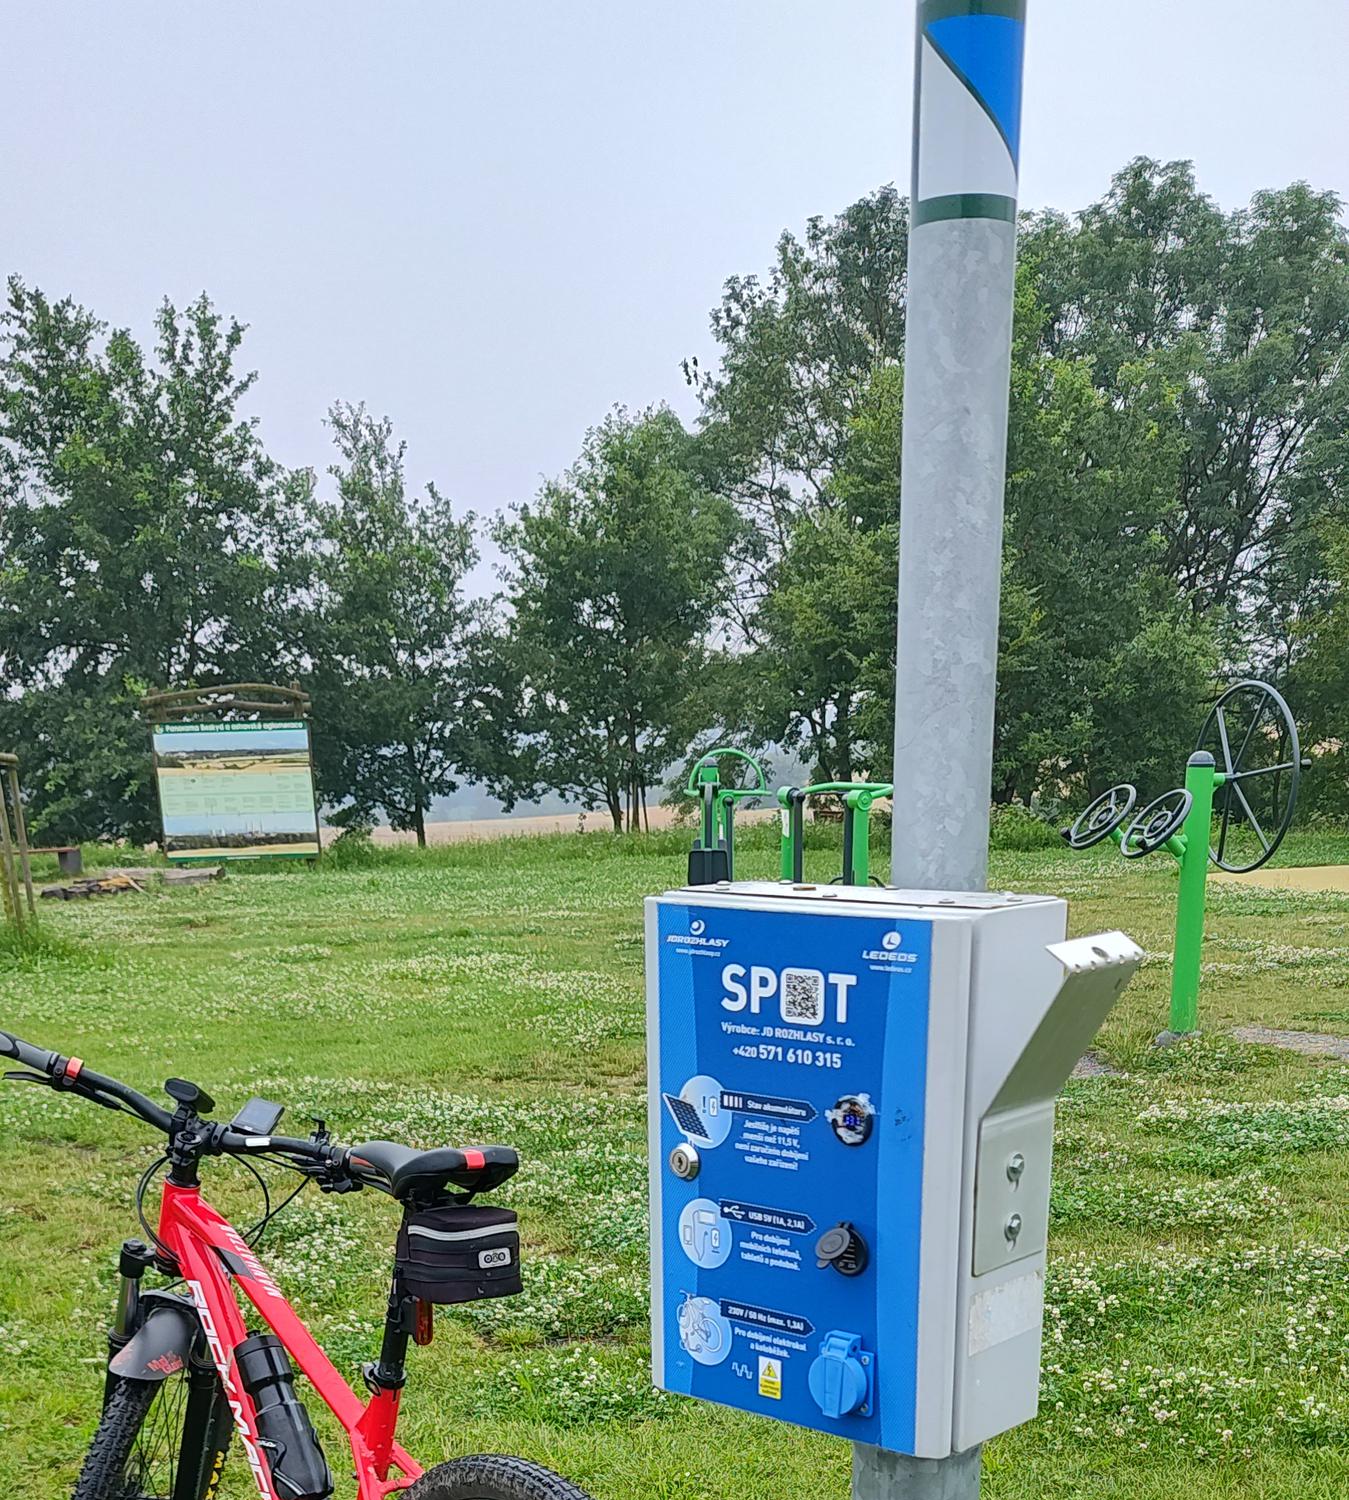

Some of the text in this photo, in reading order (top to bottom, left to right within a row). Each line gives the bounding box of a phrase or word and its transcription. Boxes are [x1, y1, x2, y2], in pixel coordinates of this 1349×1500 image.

[721, 1021, 760, 1035] Výrobce:
[761, 1026, 773, 1037] JD
[775, 1027, 825, 1043] ROZHLASY
[732, 1044, 841, 1068] +420 571 610 315
[748, 1211, 762, 1221] USB
[187, 1280, 237, 1398] ROCK
[734, 1326, 746, 1337] Pro
